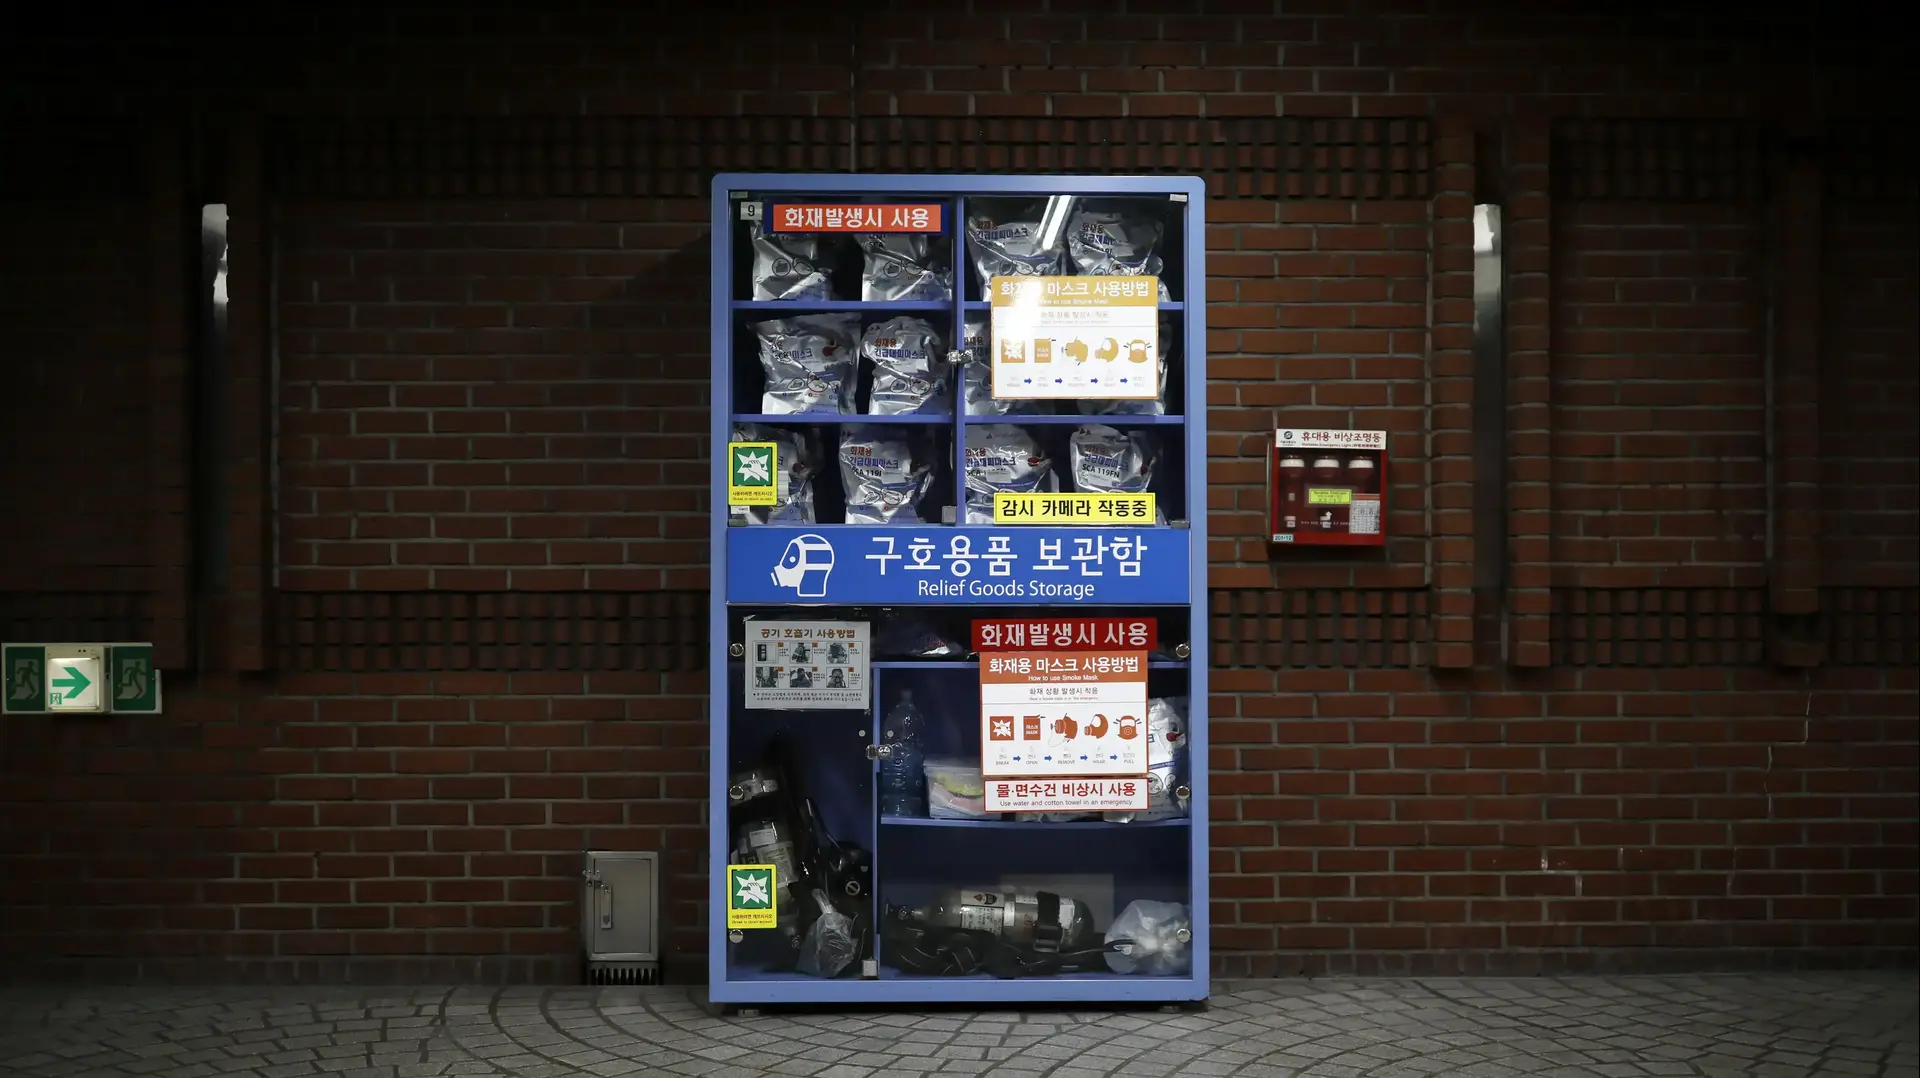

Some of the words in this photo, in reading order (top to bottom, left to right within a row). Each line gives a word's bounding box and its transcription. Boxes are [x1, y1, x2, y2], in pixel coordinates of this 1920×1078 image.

[747, 204, 756, 217] 9
[785, 207, 882, 228] 화재발생시
[891, 207, 929, 228] 사용
[1047, 281, 1089, 297] 마스크
[1092, 281, 1149, 297] 사용방법
[1301, 431, 1331, 442] 휴대용
[1334, 431, 1382, 443] 비상조명등
[850, 446, 872, 456] 화재용
[850, 457, 899, 469] 긴급대피마스크
[1082, 464, 1095, 472] SCA
[1098, 467, 1120, 478] 119FN
[1002, 499, 1034, 517] 감시
[1042, 499, 1091, 517] 카메라
[1098, 499, 1147, 517] 작동중
[865, 535, 1018, 577] 구호용품
[1032, 535, 1148, 576] 보관함
[918, 580, 966, 596] Relief
[969, 580, 1024, 596] Goods
[1029, 580, 1095, 600] Storage
[761, 628, 780, 638] 공기
[784, 628, 813, 638] 호흡기
[816, 628, 855, 638] 사용방법
[981, 623, 1095, 647] 화재발생시
[1104, 622, 1148, 646] 사용
[989, 657, 1032, 674] 화재용
[1036, 657, 1079, 673] 마스크
[1082, 656, 1139, 673] 사용방법
[1061, 687, 1083, 695] 발생시
[996, 783, 1056, 798] 물·면수건
[1062, 783, 1103, 797] 비상시
[1108, 782, 1136, 797] 사용
